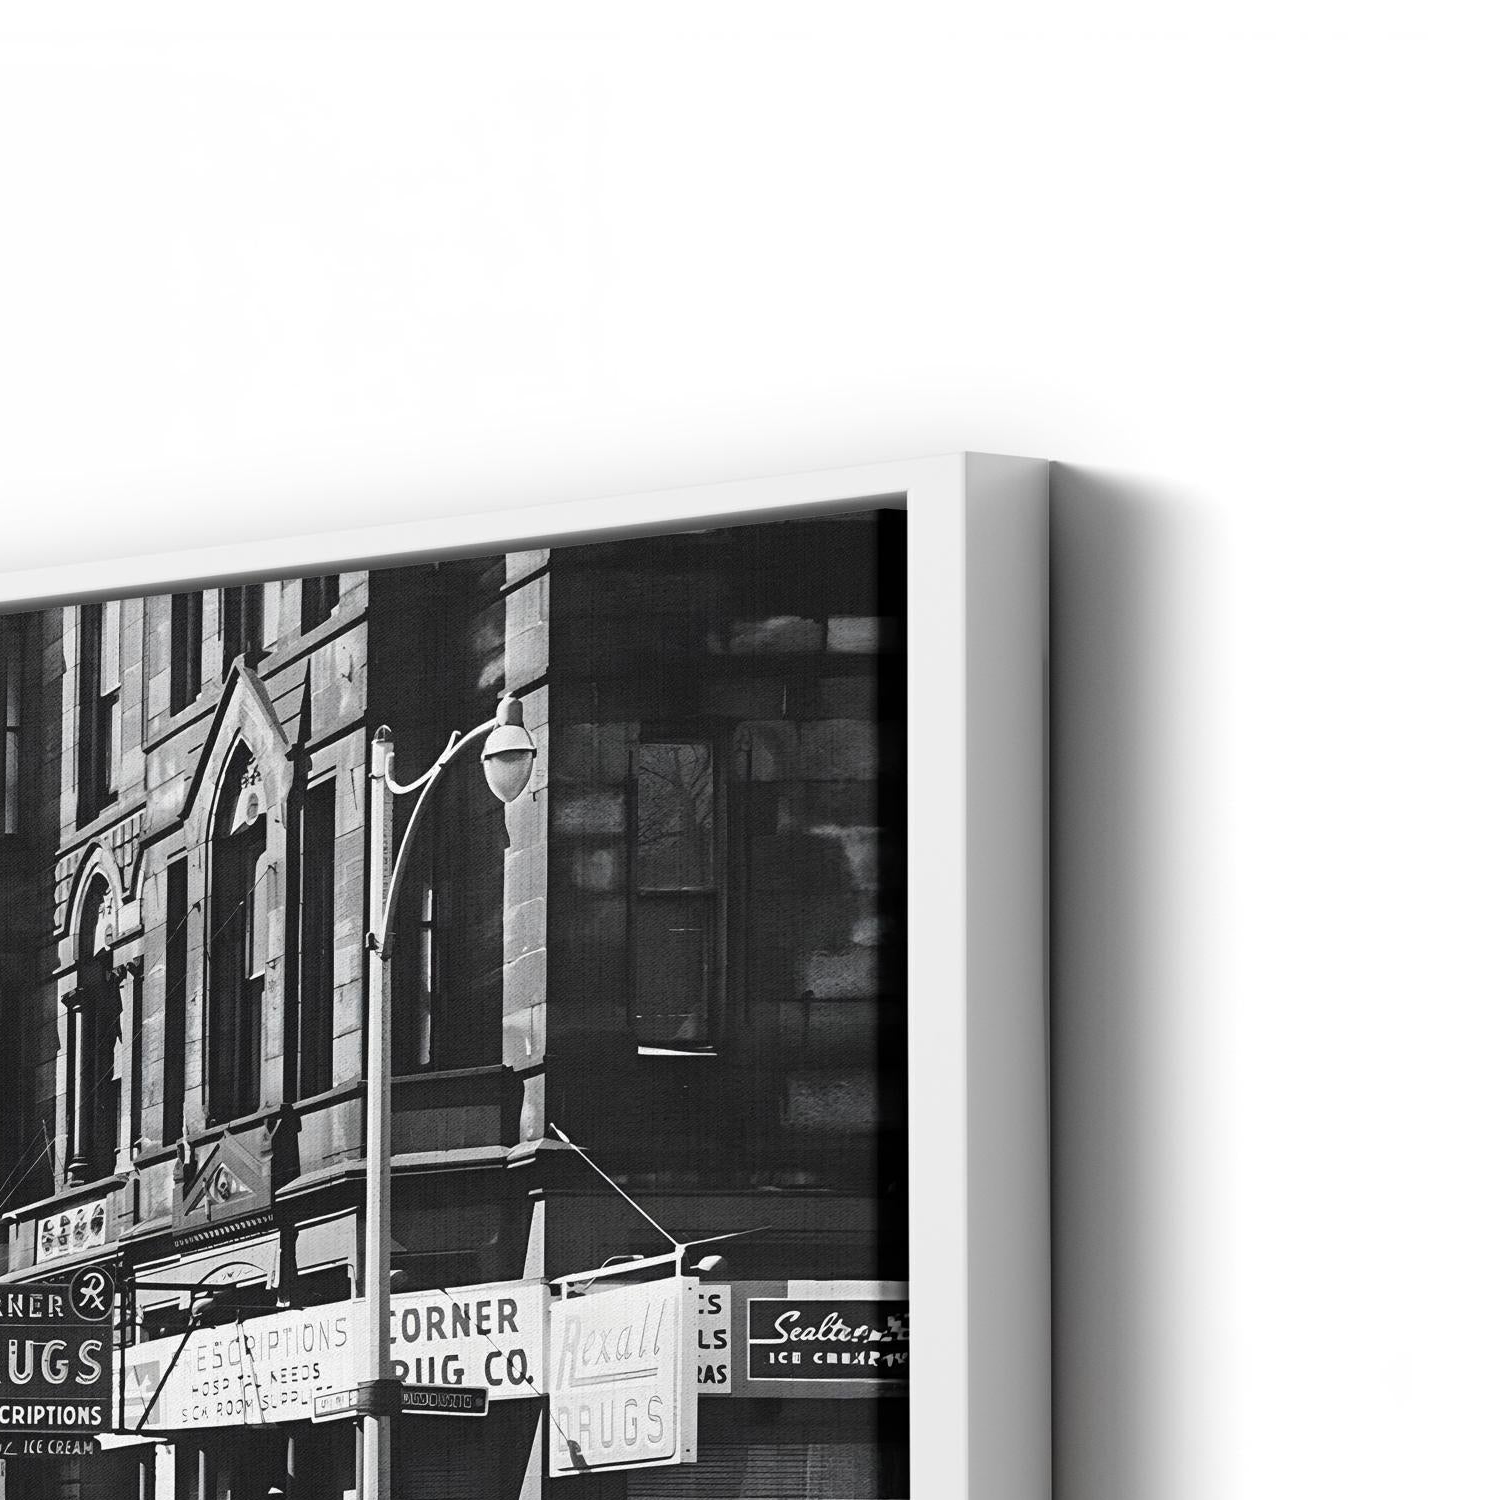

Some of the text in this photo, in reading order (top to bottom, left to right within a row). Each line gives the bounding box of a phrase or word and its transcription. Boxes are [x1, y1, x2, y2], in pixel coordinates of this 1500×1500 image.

[555, 1299, 667, 1391] Rexall
[389, 1353, 466, 1386] RUG
[557, 1395, 664, 1453] DRUGS
[23, 1439, 44, 1454] ICE
[47, 1440, 94, 1455] CREAM
